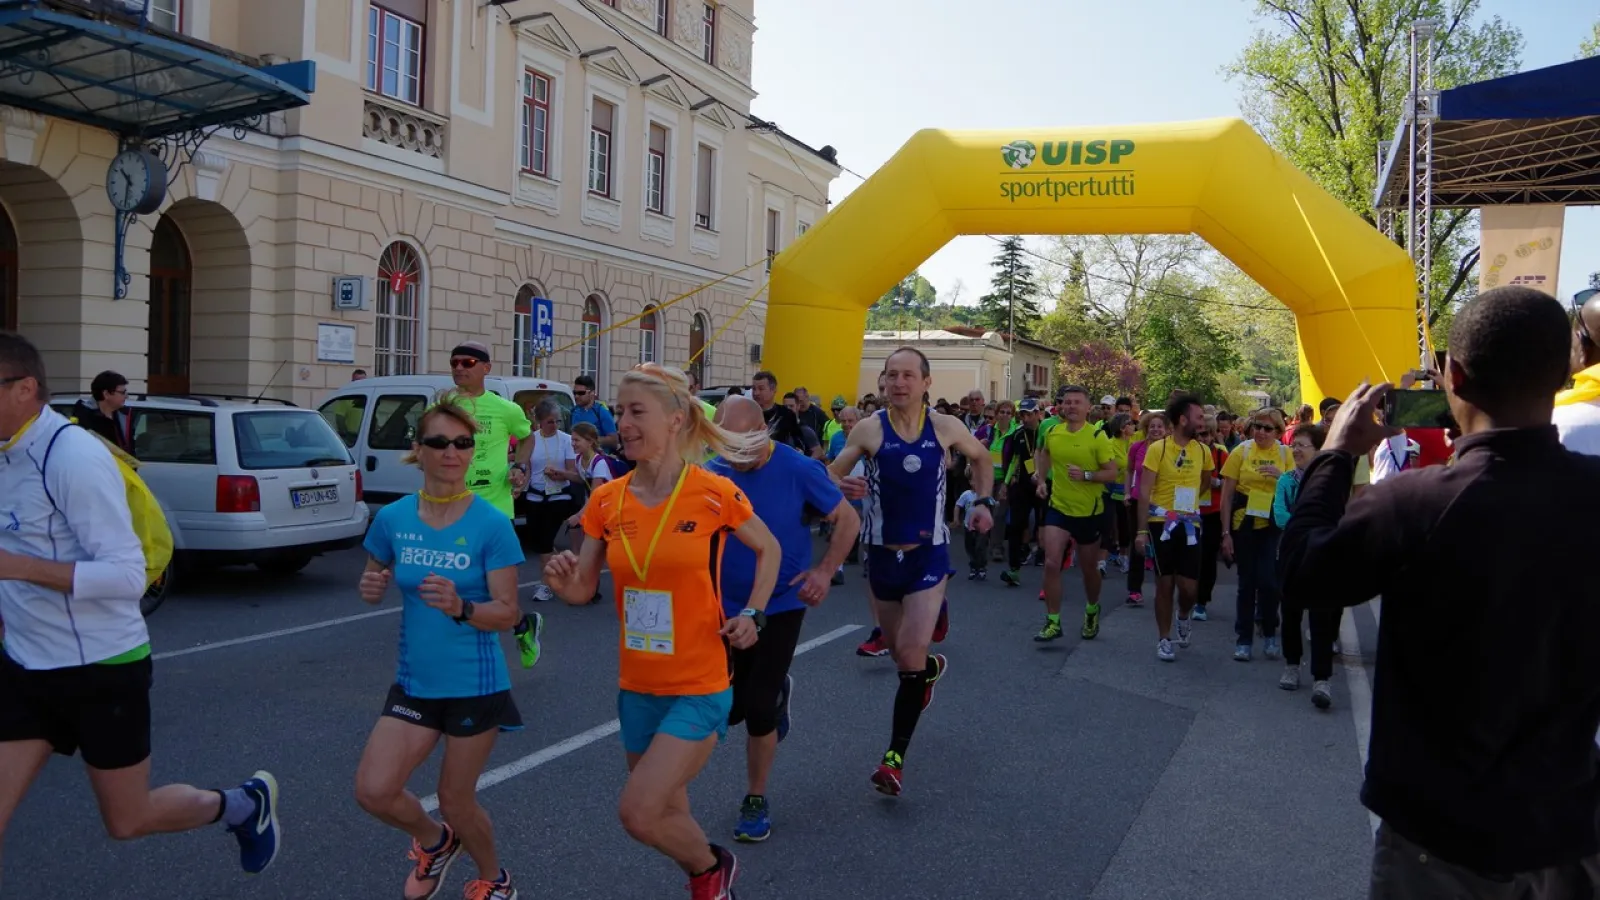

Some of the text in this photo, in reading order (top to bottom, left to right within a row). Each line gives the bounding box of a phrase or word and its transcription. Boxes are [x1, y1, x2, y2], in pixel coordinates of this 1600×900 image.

[1041, 139, 1135, 166] UISP
[999, 173, 1135, 203] sportpertutti
[300, 492, 311, 505] GO
[395, 532, 424, 541] SARA
